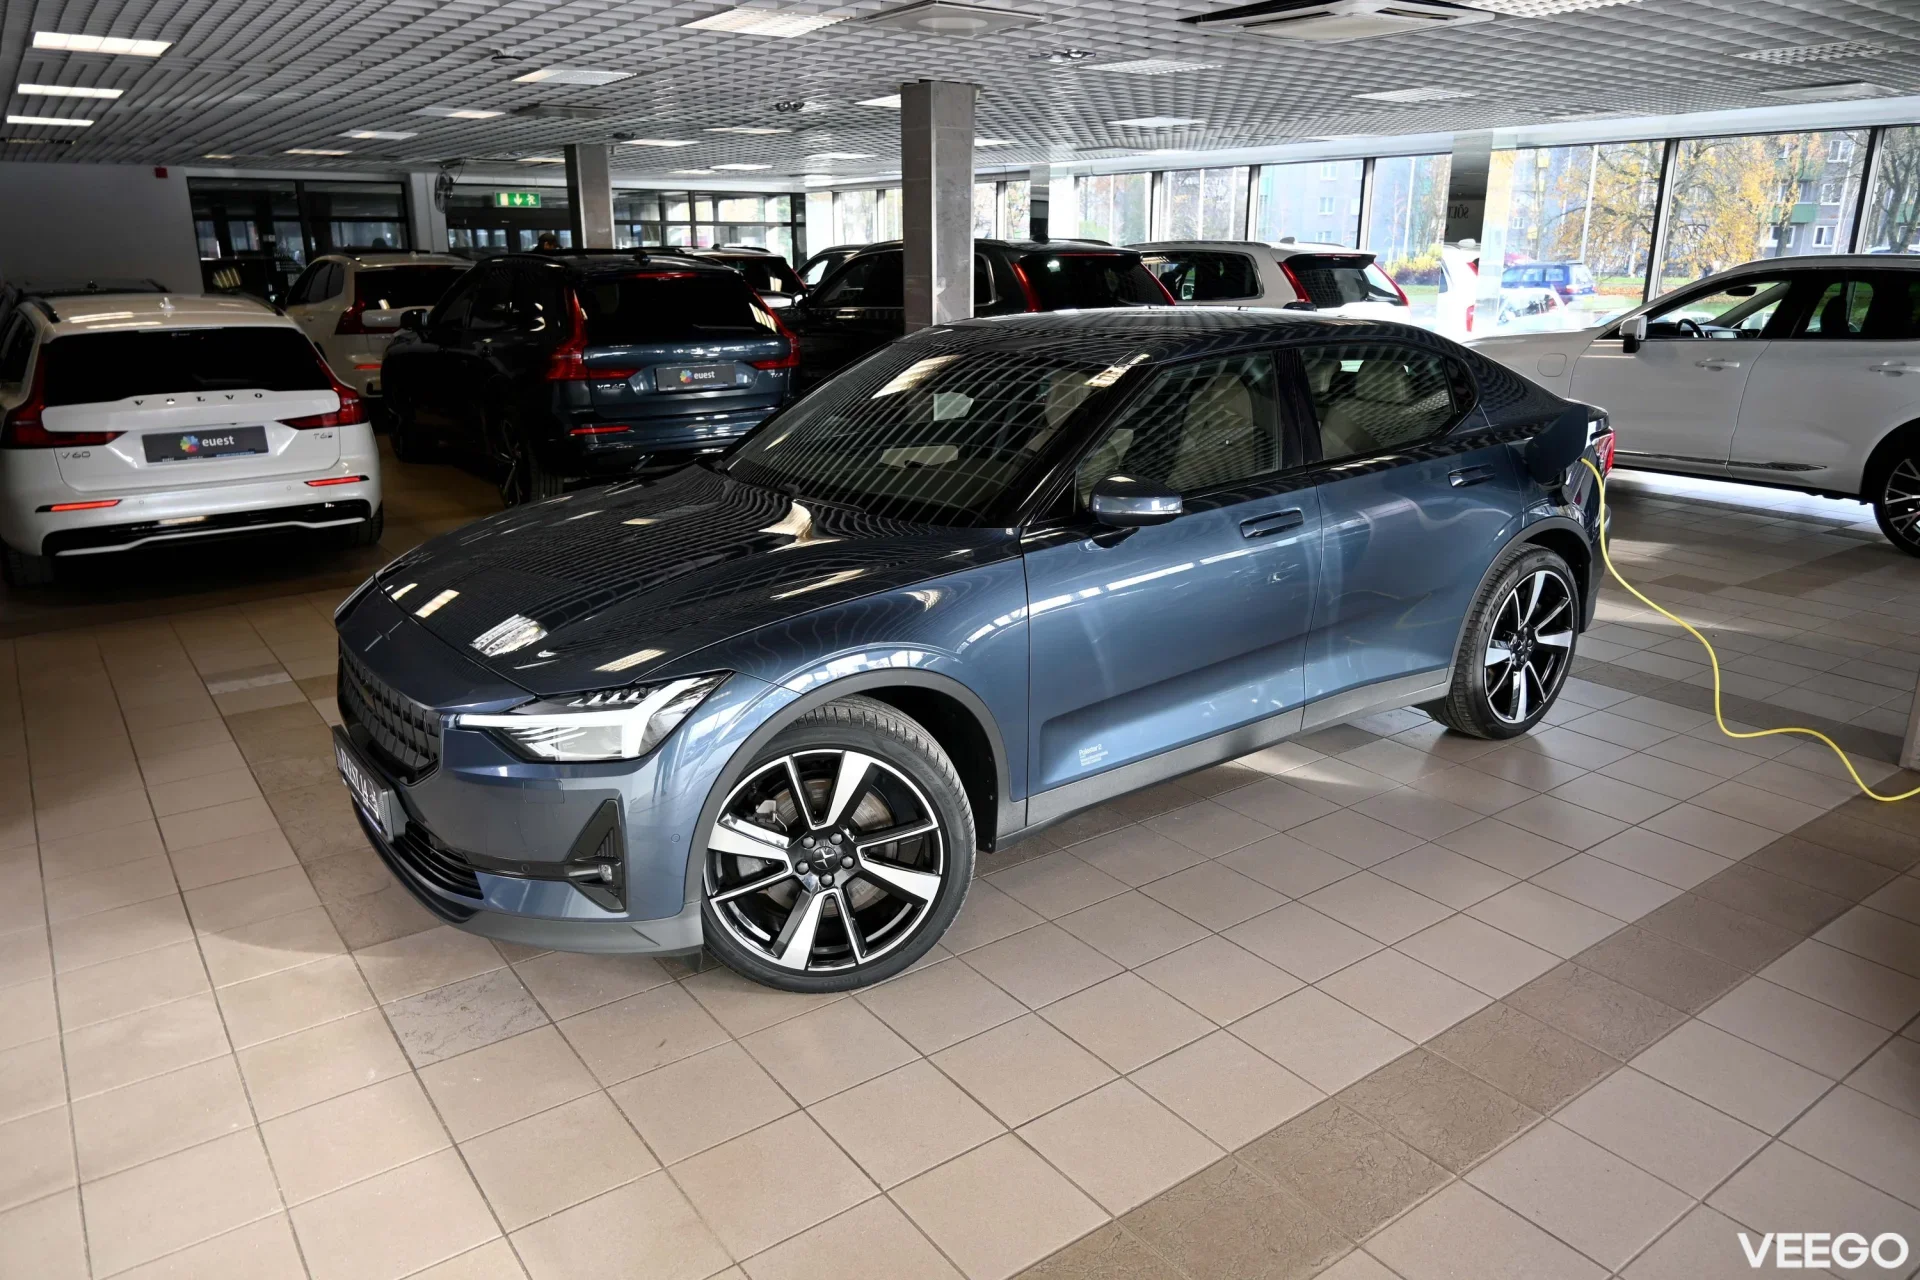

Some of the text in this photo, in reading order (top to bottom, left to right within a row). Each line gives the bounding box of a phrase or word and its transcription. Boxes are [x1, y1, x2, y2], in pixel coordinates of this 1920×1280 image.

[694, 371, 715, 380] euest
[133, 392, 263, 406] VOLVO
[202, 435, 235, 447] euest
[60, 451, 91, 459] V60
